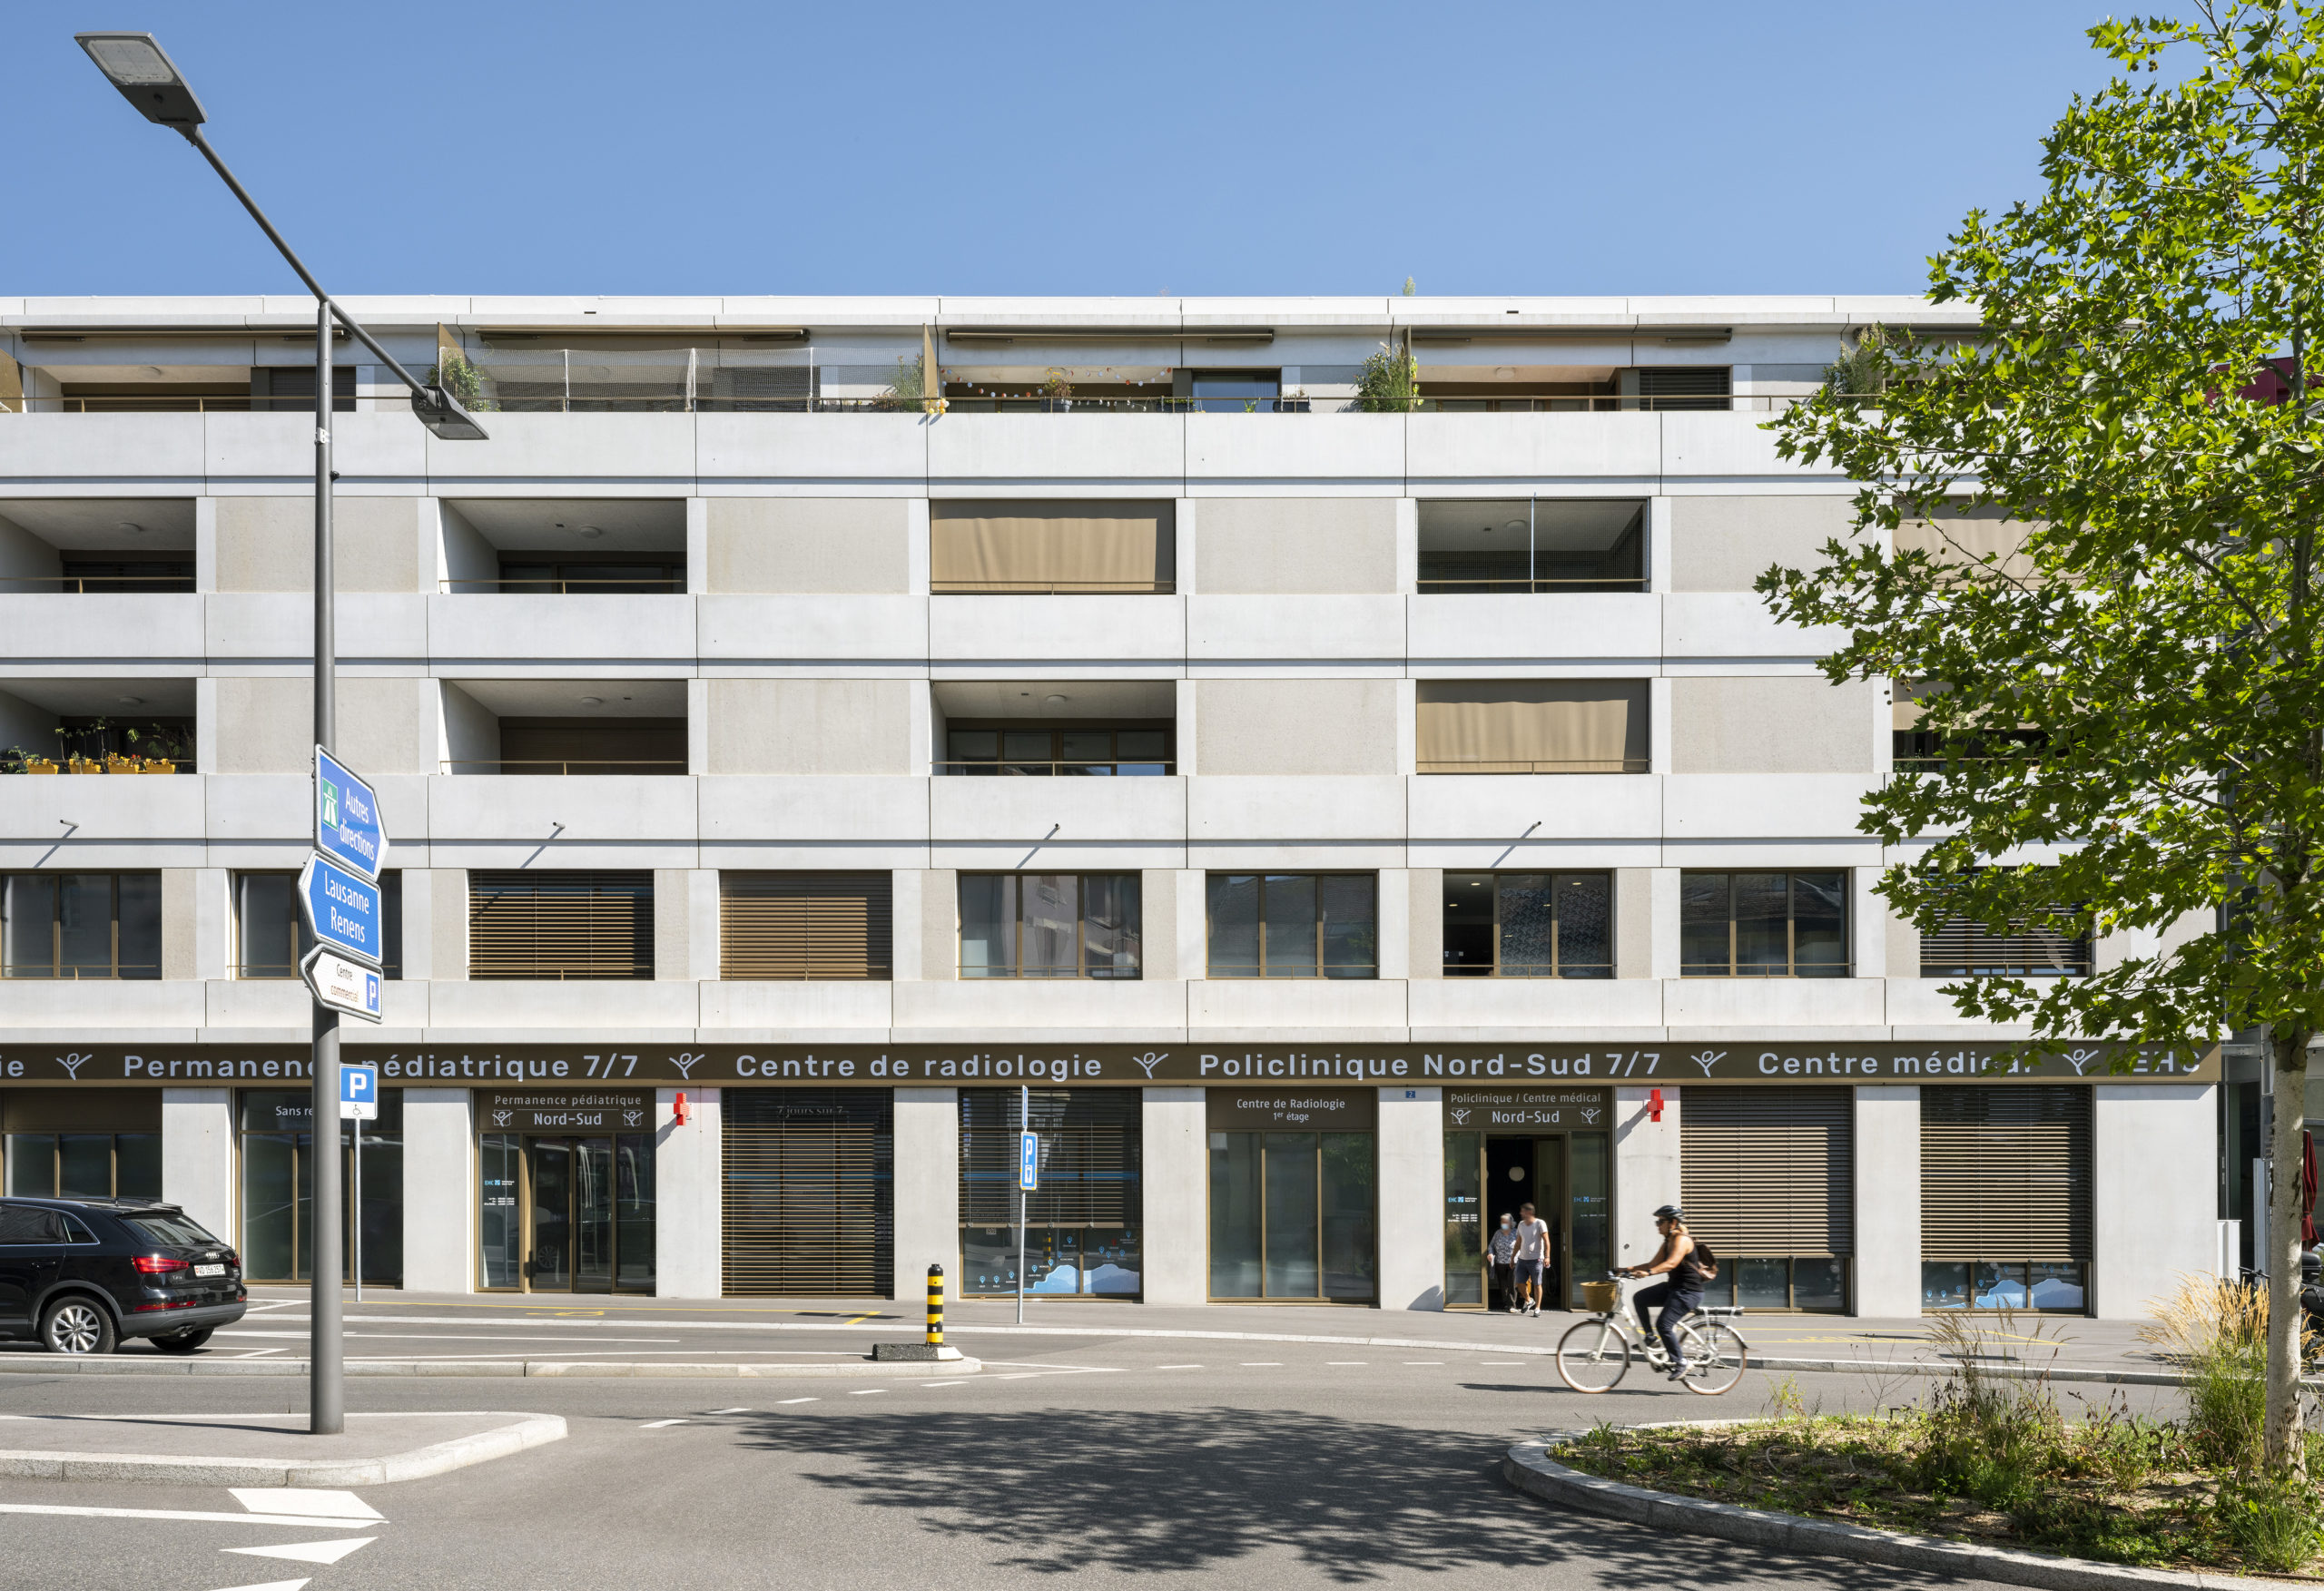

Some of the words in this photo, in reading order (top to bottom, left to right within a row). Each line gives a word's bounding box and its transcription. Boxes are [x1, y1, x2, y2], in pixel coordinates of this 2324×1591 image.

[345, 787, 369, 823] Autres
[340, 818, 375, 861] directions
[324, 870, 369, 915] Lausanne
[330, 906, 365, 943] Renens
[336, 963, 353, 981] Centre
[369, 980, 377, 1007] P
[124, 1056, 343, 1077] Permanen
[583, 1053, 638, 1078] 7/7
[736, 1055, 855, 1076] Centre
[870, 1055, 910, 1076] de
[924, 1054, 1102, 1082] radiologie
[1199, 1054, 1409, 1081] Policlinique
[1423, 1053, 1591, 1076] Nord-Sud
[1606, 1051, 1660, 1077] 7/7
[1758, 1052, 1878, 1075] Centre
[349, 1072, 367, 1099] P
[1407, 1090, 1413, 1098] 2
[275, 1105, 301, 1116] Sans
[495, 1095, 566, 1105] Permanence
[572, 1095, 641, 1107] pédiatrique
[1236, 1098, 1270, 1109] Centre
[1274, 1098, 1286, 1109] de
[1290, 1098, 1345, 1111] Radiologie
[1451, 1093, 1512, 1105] Policlinique
[1523, 1093, 1556, 1103] Centre
[1560, 1093, 1600, 1103] médical
[534, 1113, 602, 1125] Nord-Sud
[1273, 1111, 1284, 1121] 1er
[1286, 1111, 1309, 1123] étage
[1492, 1110, 1560, 1124] Nord-Sud
[1025, 1138, 1033, 1164] P
